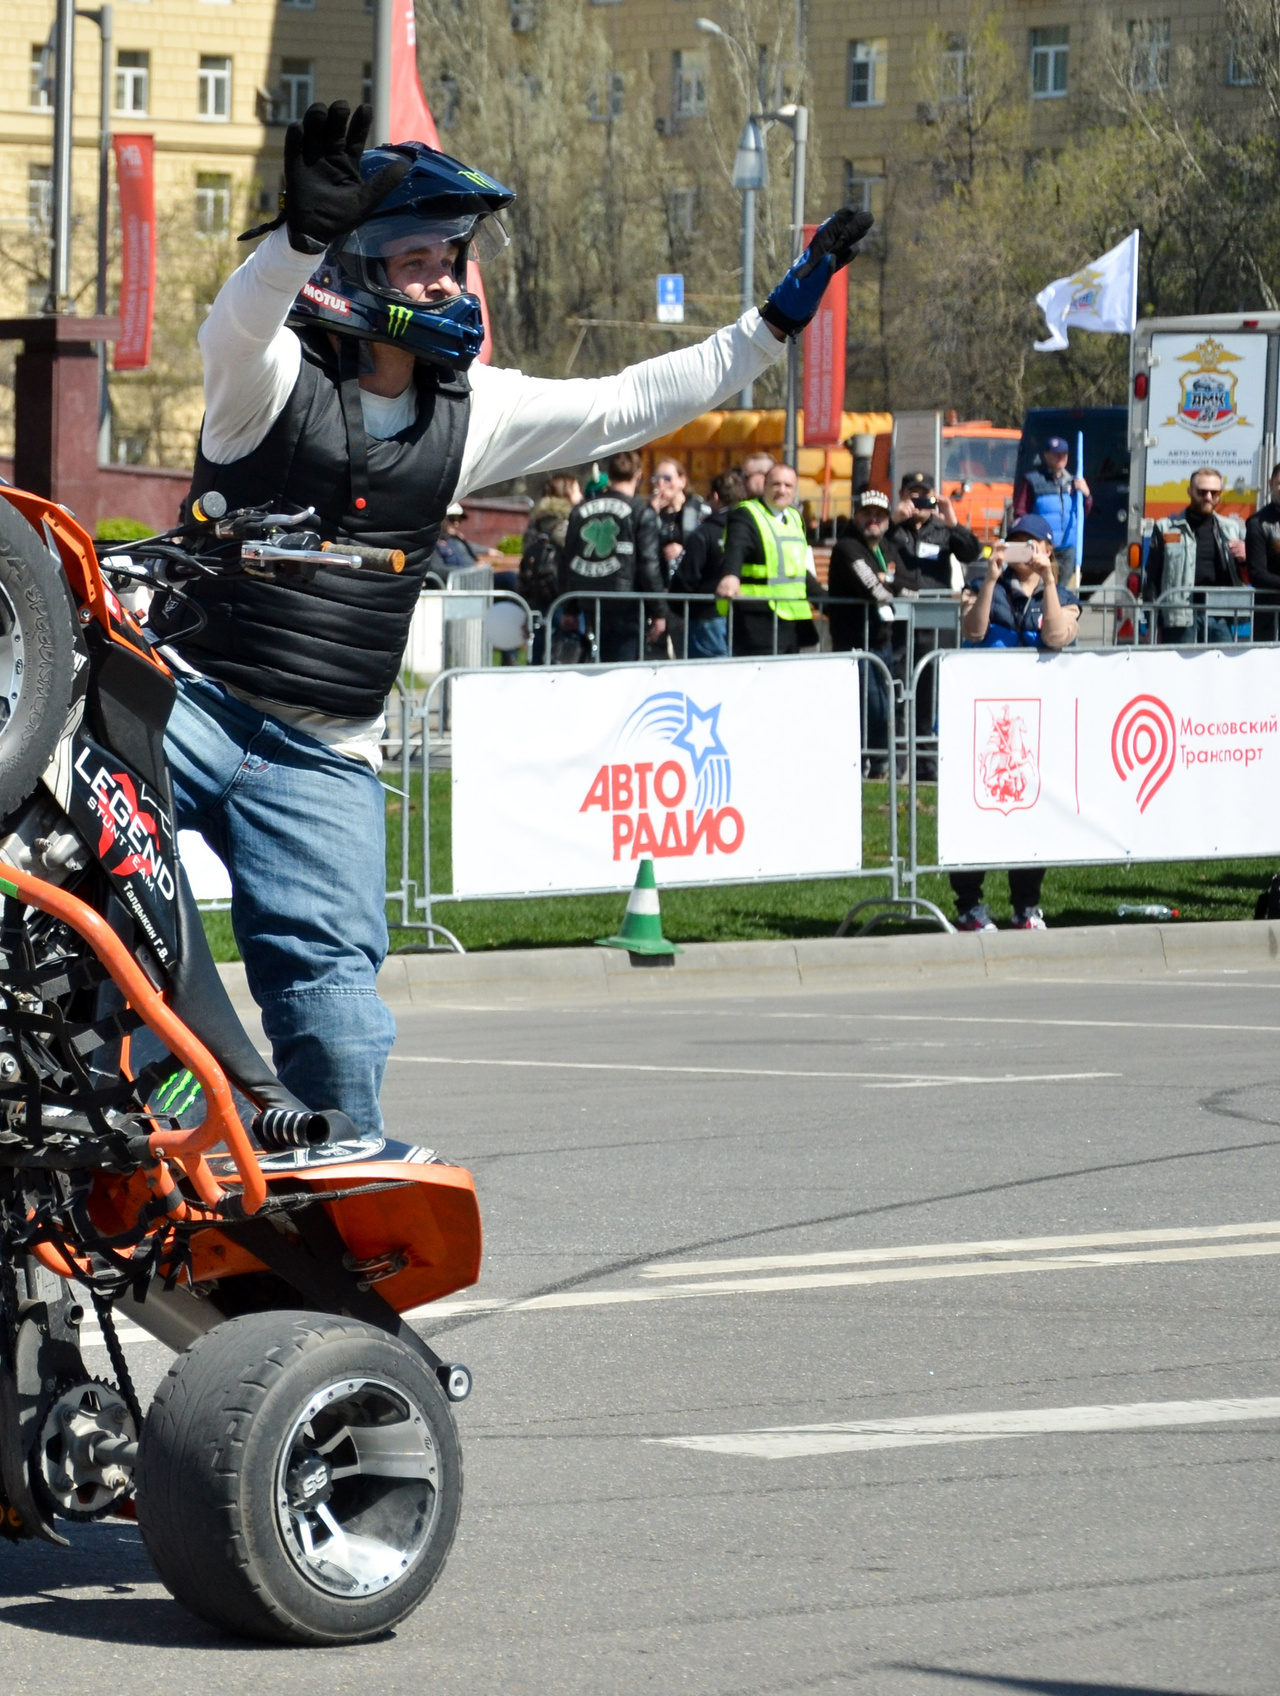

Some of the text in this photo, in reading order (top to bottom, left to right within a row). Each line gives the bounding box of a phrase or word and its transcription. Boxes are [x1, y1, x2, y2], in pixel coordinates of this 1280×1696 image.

[303, 283, 349, 313] MOTUL
[1180, 714, 1278, 737] Московский
[1180, 745, 1263, 769] Транспорт
[580, 760, 688, 814] АВТО
[74, 746, 175, 901] LEGEND
[87, 798, 155, 892] STUNT TEAM
[613, 806, 745, 861] РАДИО
[122, 881, 169, 963] Талдыкин Г.В.
[303, 1465, 328, 1498] SS
